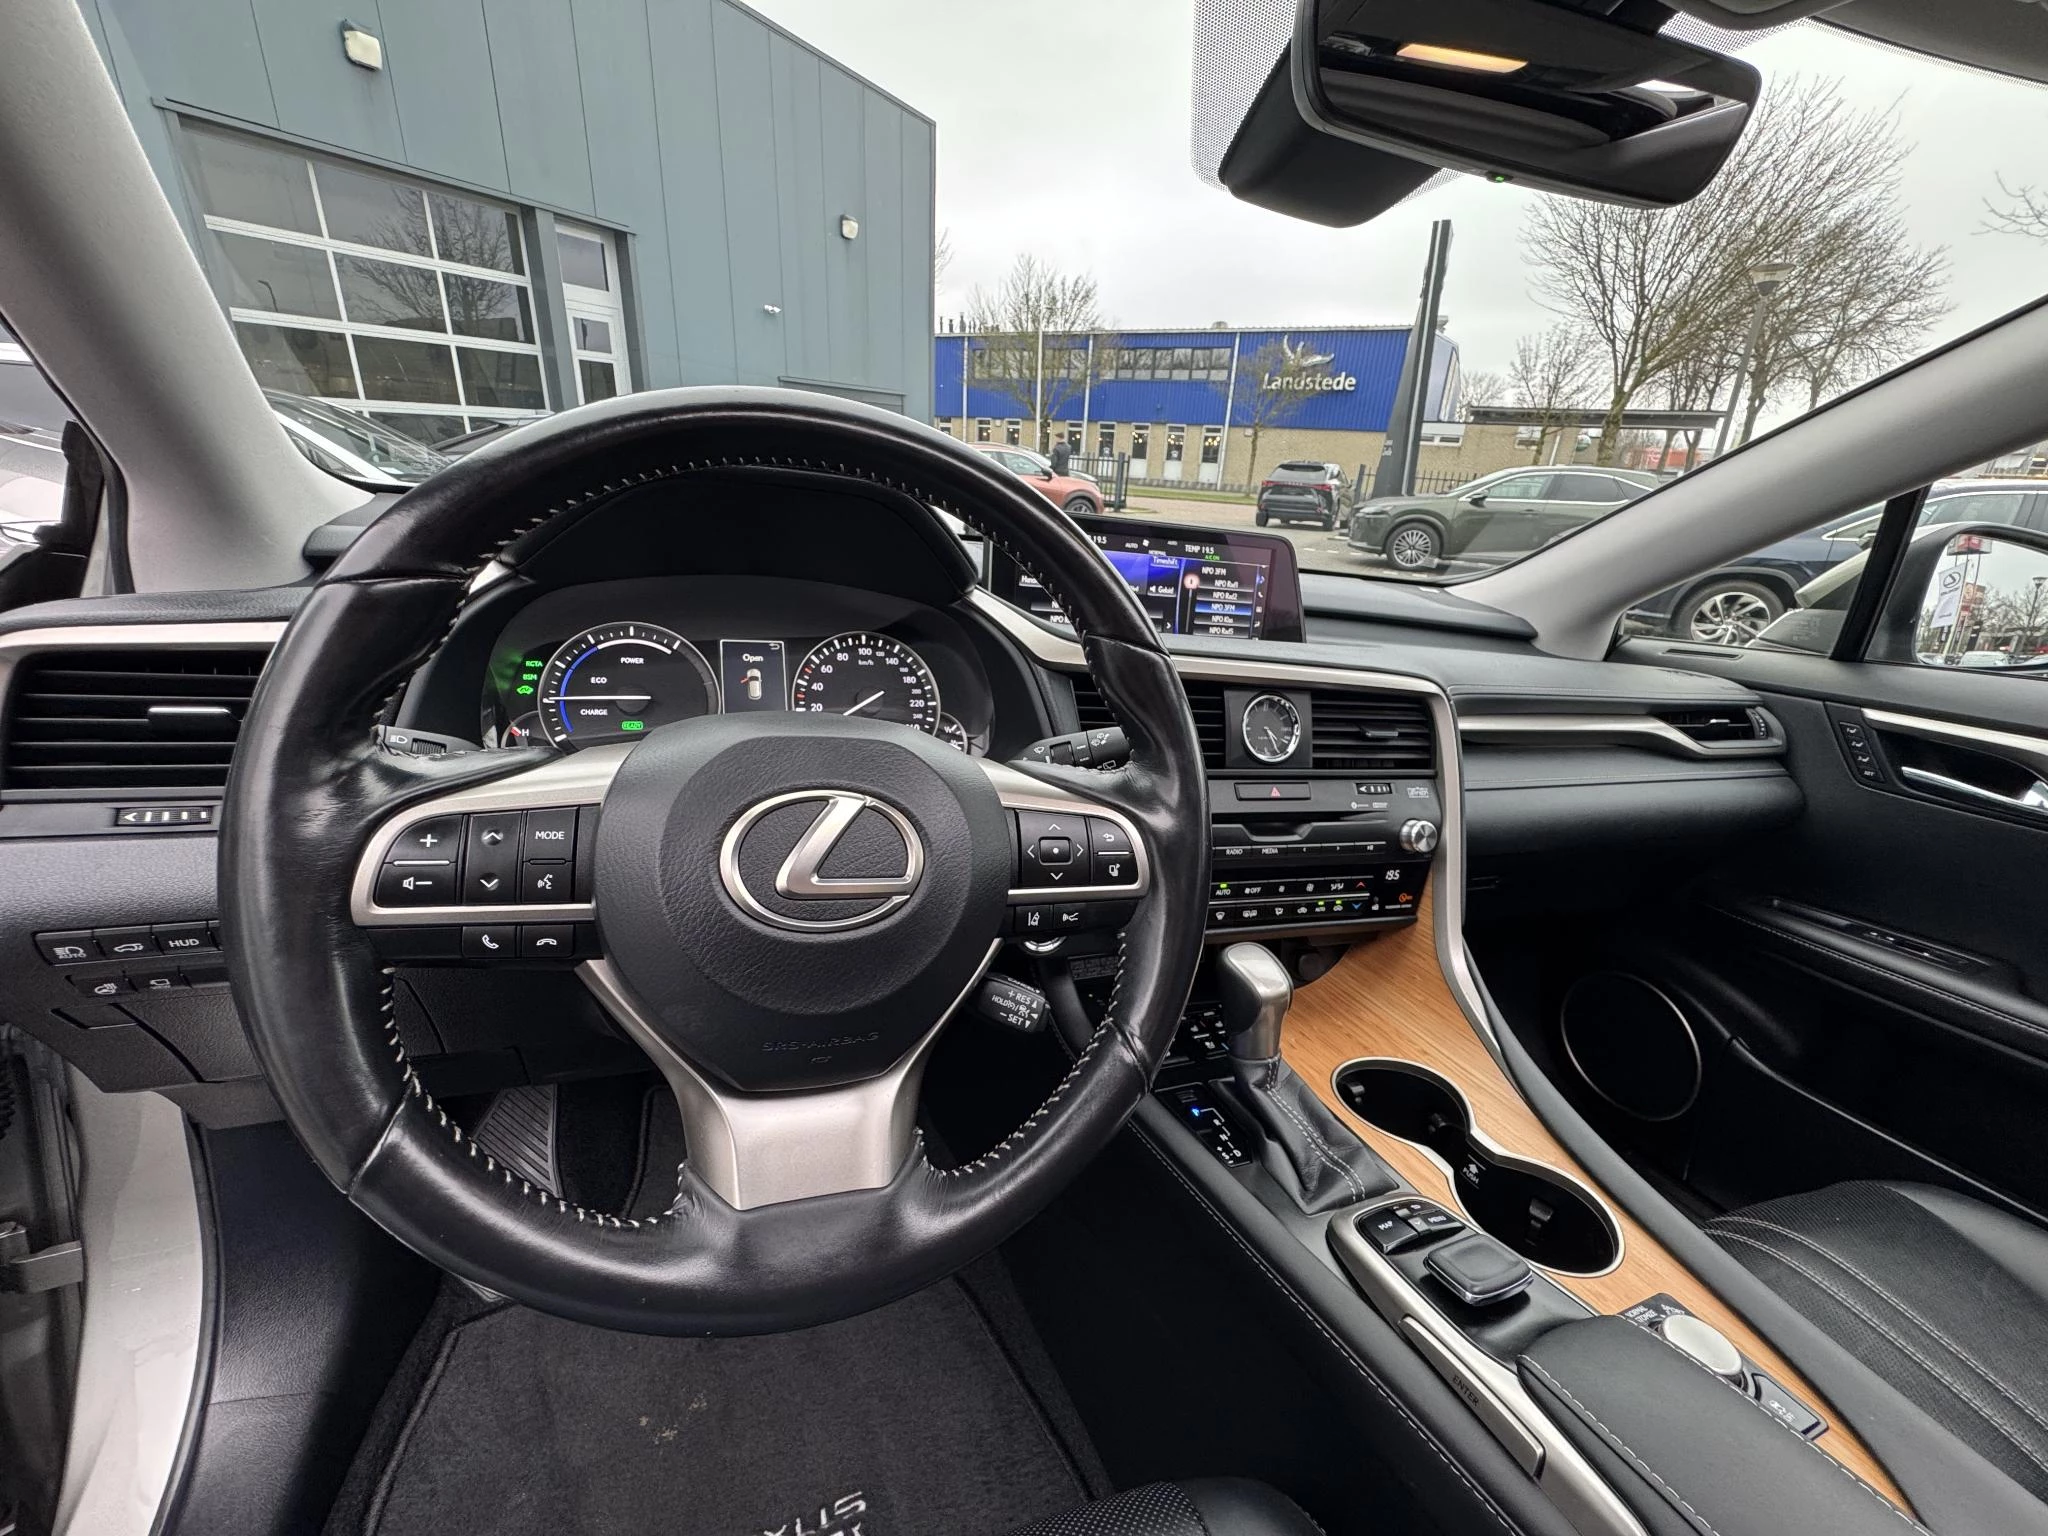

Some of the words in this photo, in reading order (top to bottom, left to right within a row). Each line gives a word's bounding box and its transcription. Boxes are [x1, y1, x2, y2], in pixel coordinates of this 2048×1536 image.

[1262, 371, 1357, 391] Landstede
[1185, 544, 1200, 554] TEMP
[1153, 556, 1178, 566] Timeshift
[1201, 566, 1214, 575] NPO
[1214, 567, 1227, 576] 3FM
[1214, 579, 1226, 587] NPO
[1212, 591, 1224, 599] NPO
[1211, 603, 1223, 611] NPO
[1223, 604, 1236, 612] 3FM
[1211, 615, 1223, 623] NPO
[1209, 627, 1221, 635] NPO
[857, 647, 873, 656] 100
[620, 656, 645, 665] POWER
[742, 653, 764, 663] Open
[836, 652, 849, 662] 80
[885, 657, 899, 665] 140
[525, 660, 543, 668] RCTA
[820, 664, 833, 674] 60
[522, 673, 537, 681] BSM
[590, 676, 608, 685] ECO
[902, 675, 917, 684] 180
[811, 682, 824, 692] 40
[810, 703, 823, 712] 20
[909, 699, 925, 708] 220
[521, 728, 530, 737] H
[535, 830, 565, 840] MODE
[1262, 847, 1279, 855] MEDIA
[1215, 888, 1231, 896] AUTO
[168, 938, 200, 949] HUD
[59, 951, 87, 960] AUTO
[991, 994, 1009, 1006] HOLD
[1015, 993, 1032, 1005] RES
[1007, 1013, 1024, 1026] SET
[1232, 1149, 1242, 1158] D
[1463, 1167, 1479, 1184] PUSH
[1377, 1220, 1393, 1231] MAP
[1452, 1374, 1480, 1407] ENTER
